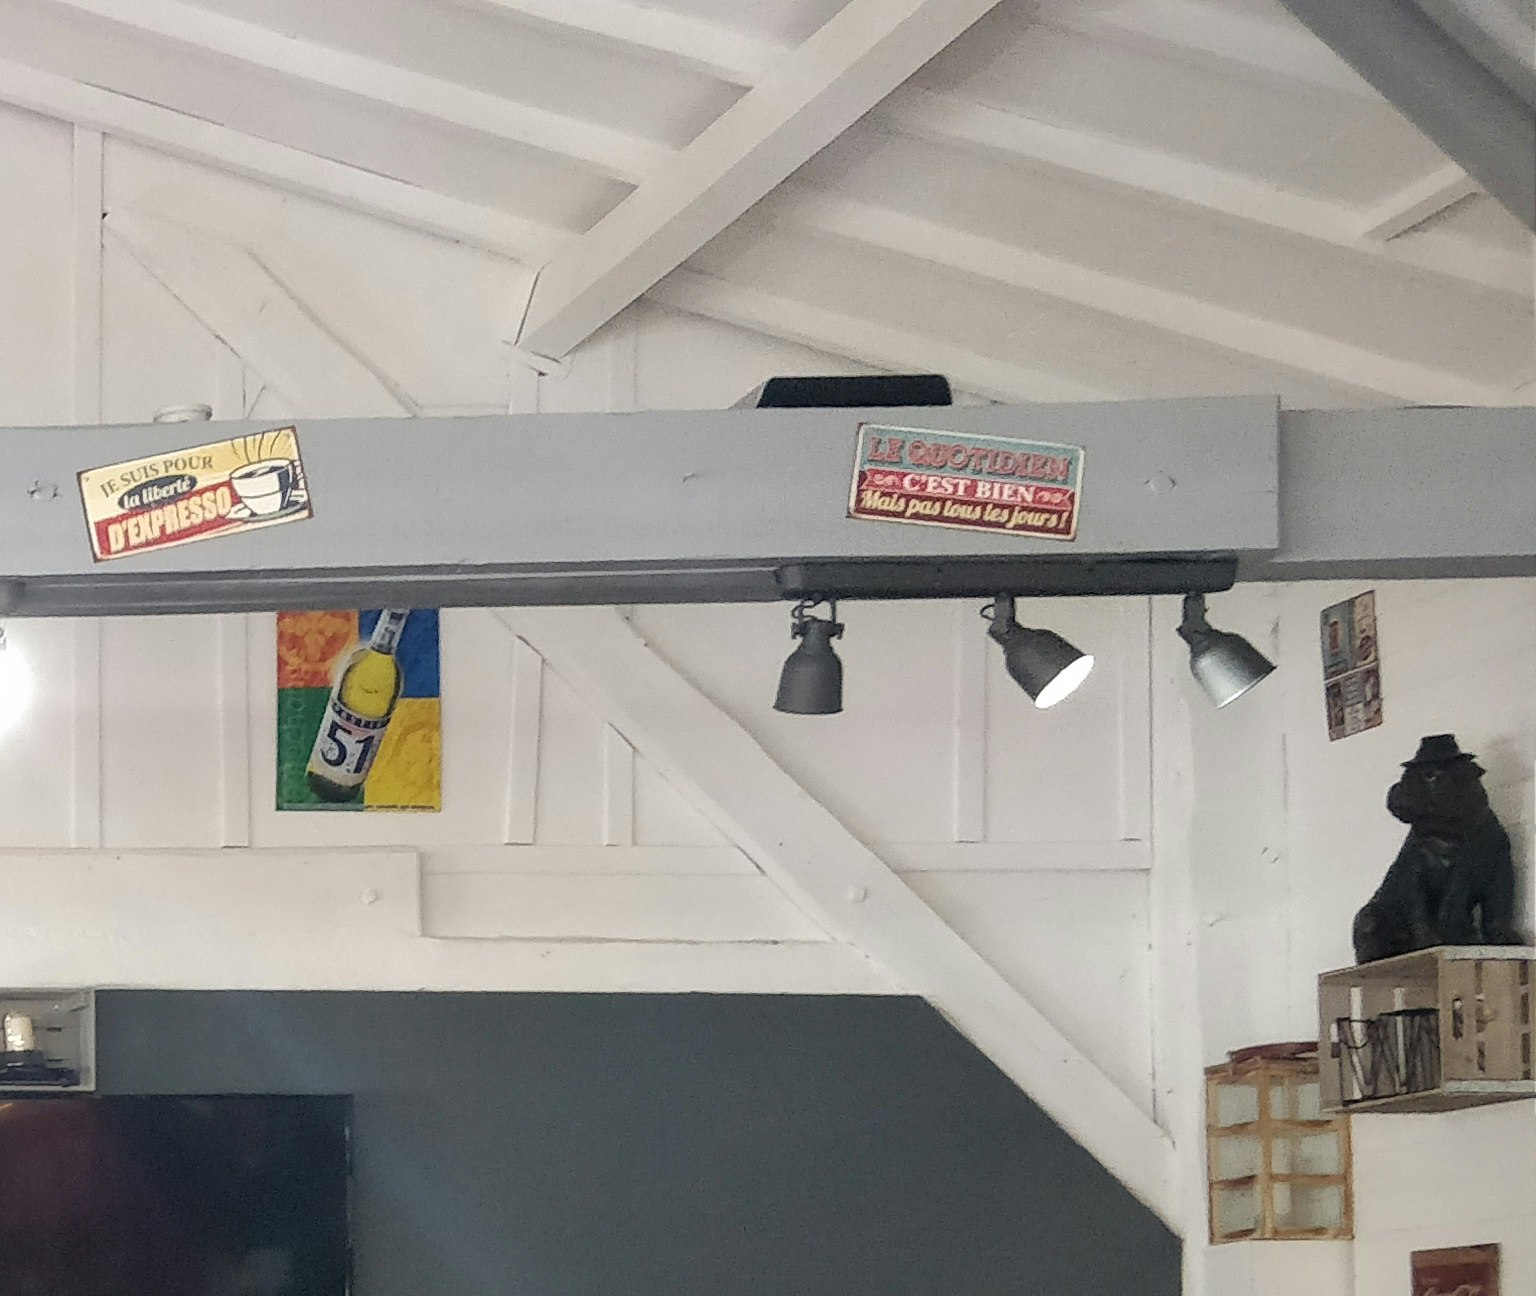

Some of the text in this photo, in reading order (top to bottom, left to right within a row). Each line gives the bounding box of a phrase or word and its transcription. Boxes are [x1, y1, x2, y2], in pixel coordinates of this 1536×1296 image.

[100, 455, 214, 498] JE SUIS POUR
[867, 436, 1071, 481] LE QUOTIDIEN
[123, 475, 192, 508] la liberté
[860, 489, 906, 513] Mais
[905, 498, 941, 518] pas
[943, 500, 981, 520] tous
[982, 503, 1009, 523] les
[902, 473, 1036, 503] C'EST BIEN
[107, 486, 233, 554] D'EXPRESSO
[320, 720, 376, 775] 51
